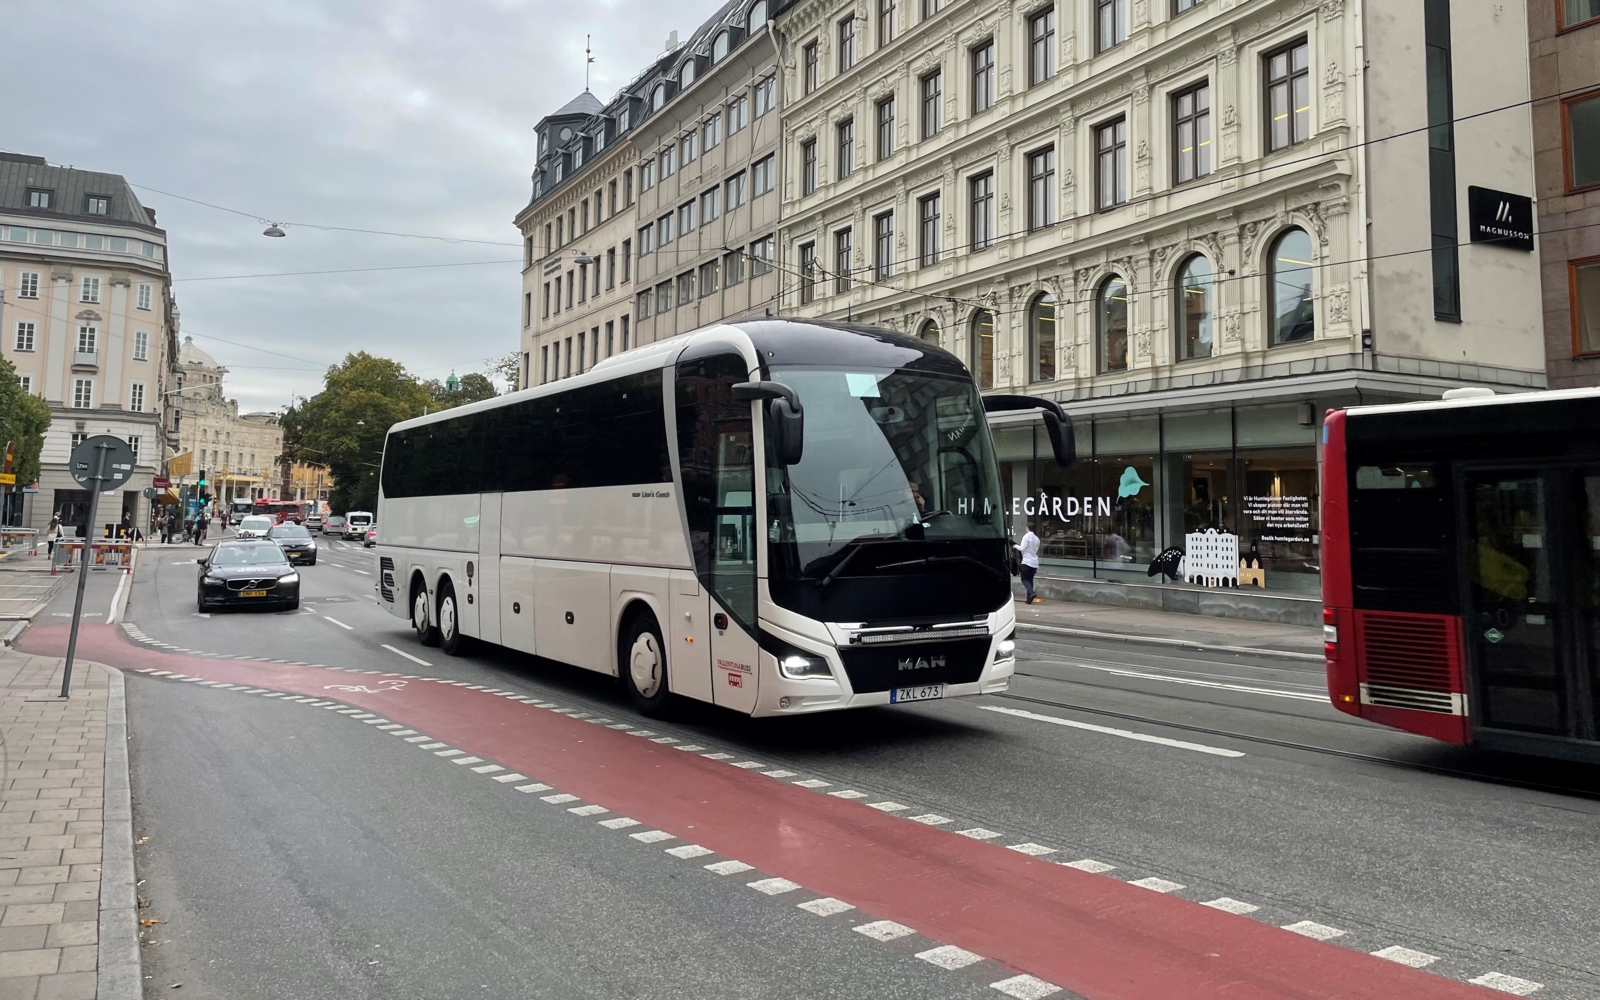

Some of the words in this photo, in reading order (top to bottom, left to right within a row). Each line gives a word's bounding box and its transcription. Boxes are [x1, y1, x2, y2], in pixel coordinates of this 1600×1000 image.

[1480, 225, 1529, 240] MAGNUSSON
[898, 655, 946, 671] MAN
[900, 688, 917, 700] ZKL
[920, 686, 939, 698] 673
